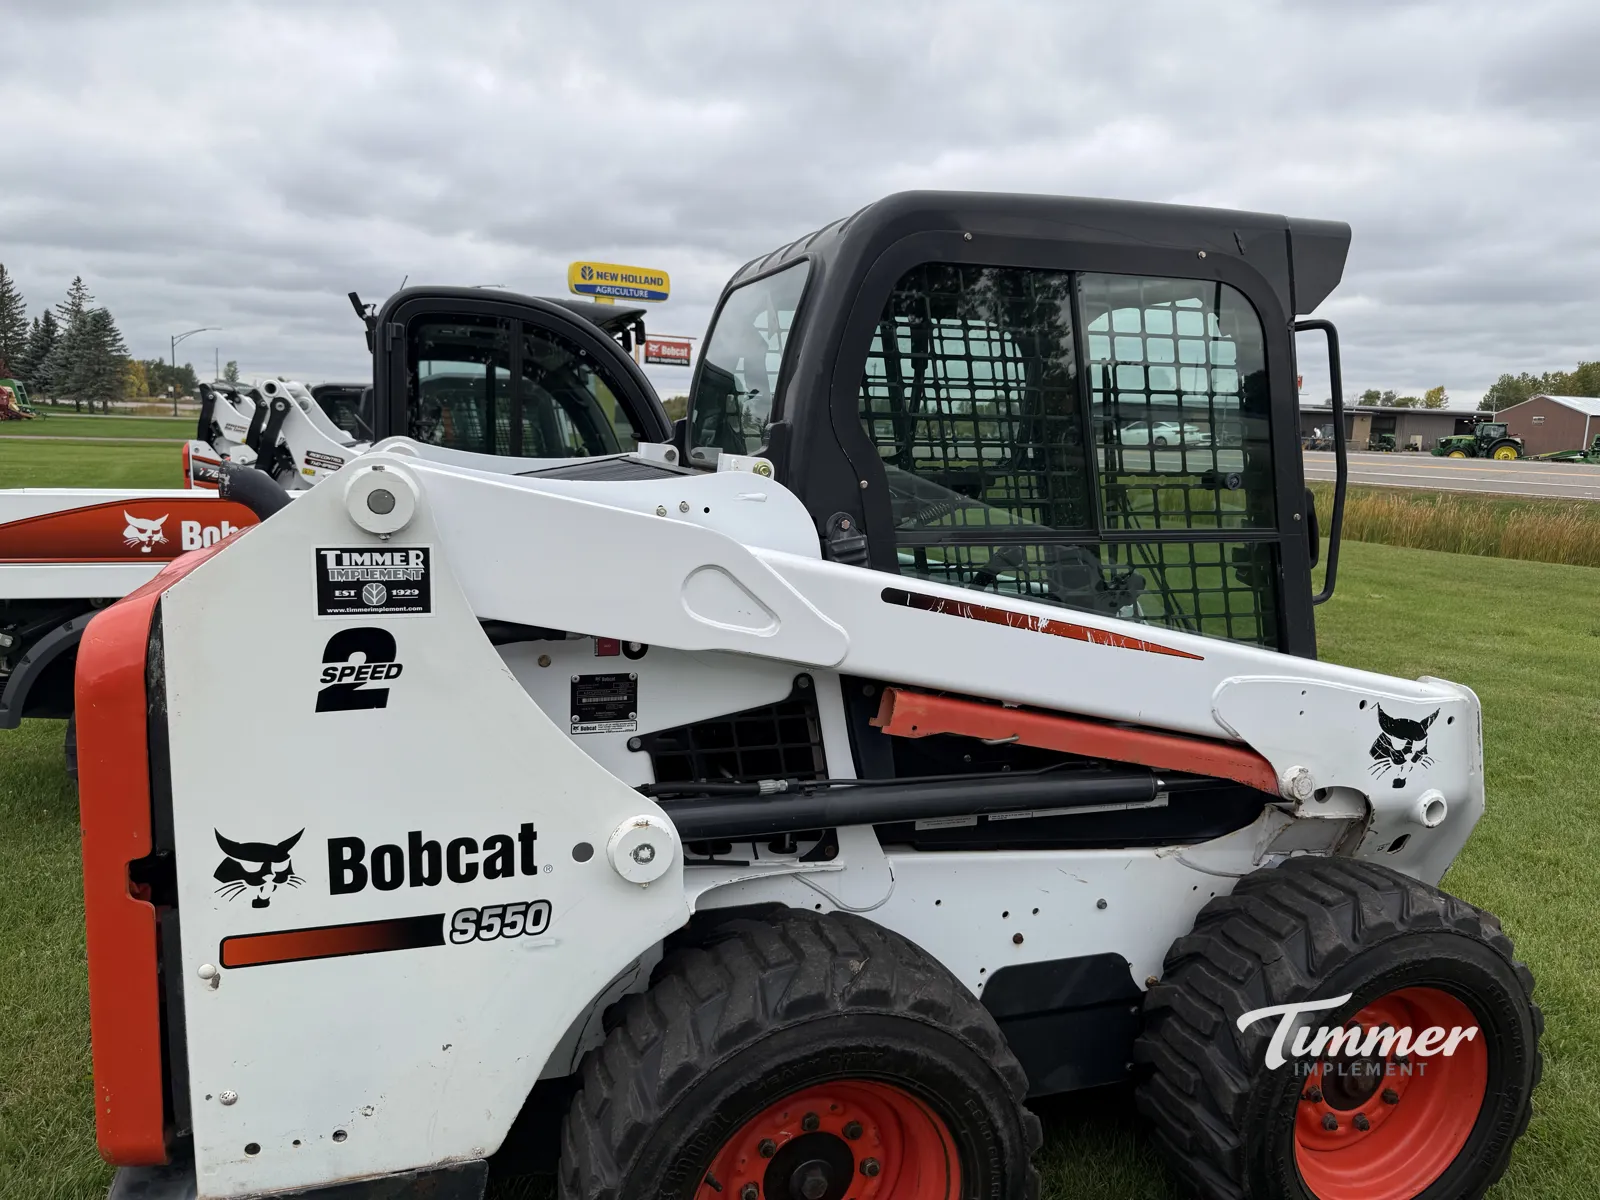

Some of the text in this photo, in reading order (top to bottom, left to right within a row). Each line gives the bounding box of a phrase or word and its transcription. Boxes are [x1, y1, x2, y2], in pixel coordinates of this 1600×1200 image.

[596, 271, 664, 287] NEW HOLLAND
[595, 286, 649, 298] AGRICULTURE
[661, 345, 688, 357] Bobcat
[320, 550, 425, 569] TIMMER
[328, 568, 425, 582] IMPLEMENT
[333, 588, 420, 597] EST 1929
[326, 605, 423, 614] www.timmerimplement.com
[315, 626, 397, 713] 2
[320, 663, 404, 684] SPEED
[327, 822, 538, 896] Bobcat
[449, 898, 553, 945] S550
